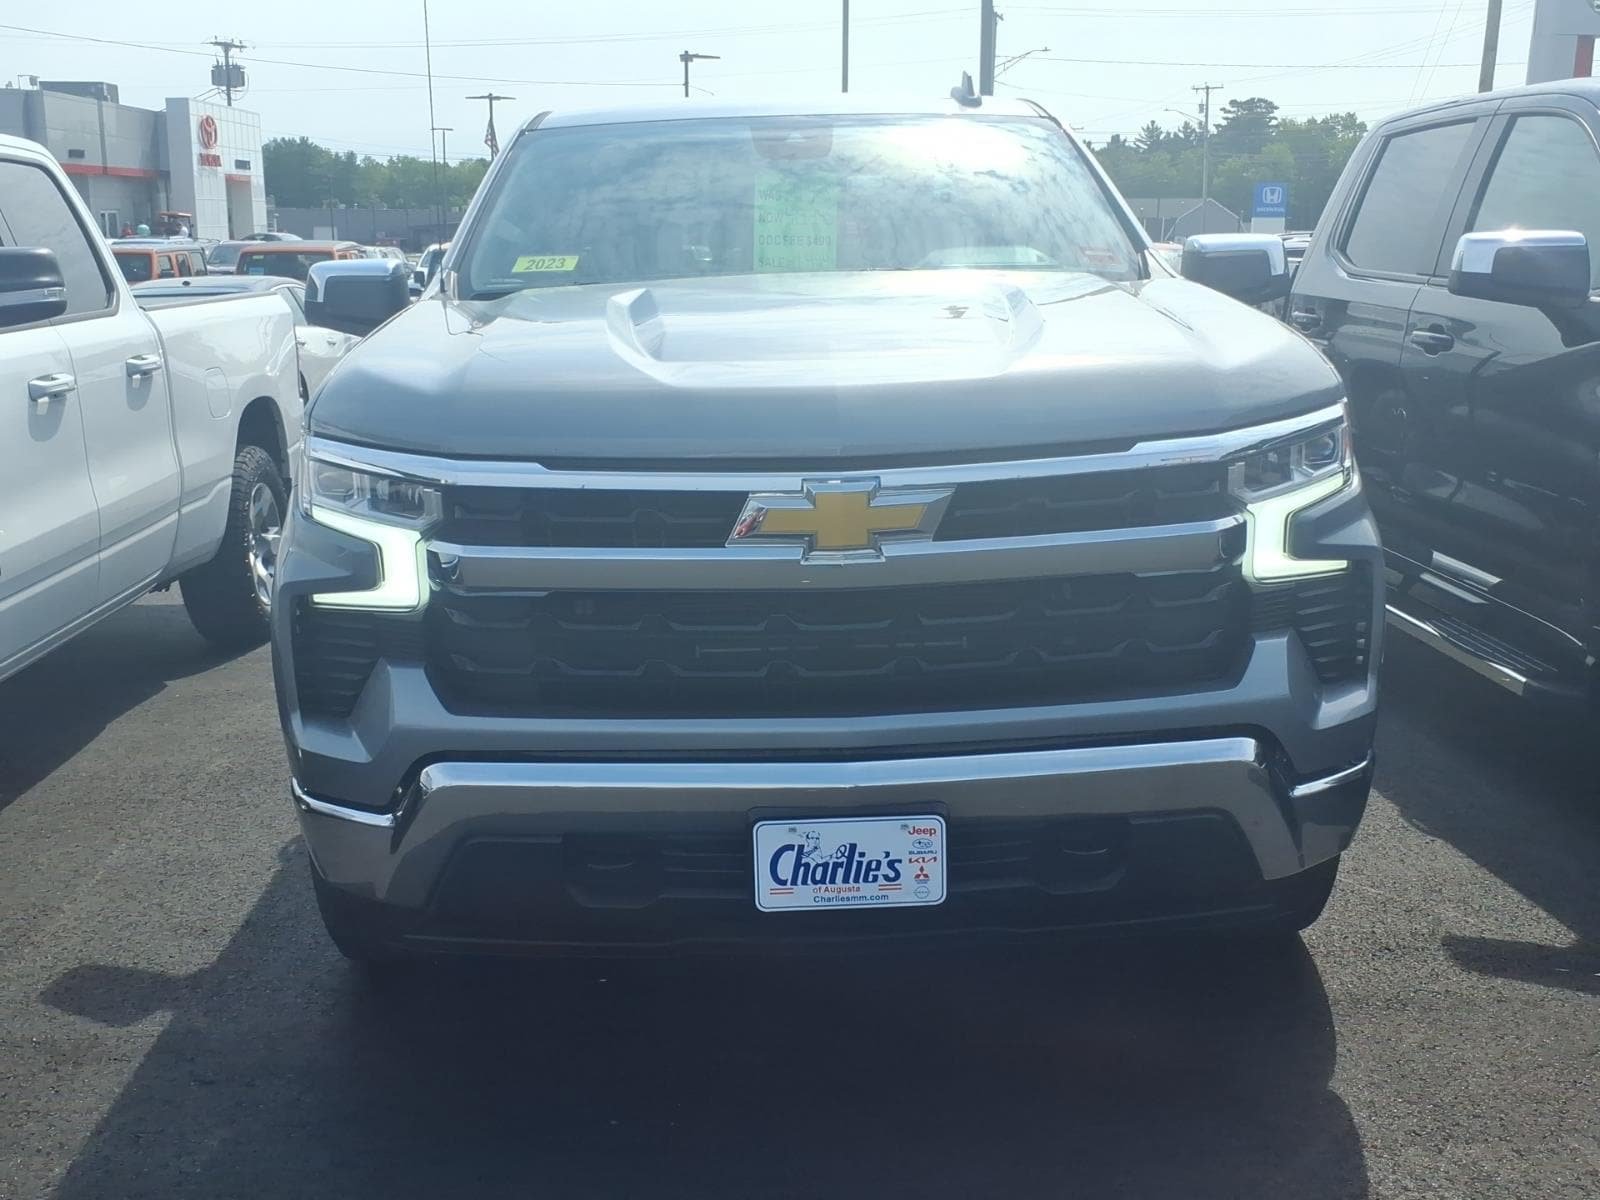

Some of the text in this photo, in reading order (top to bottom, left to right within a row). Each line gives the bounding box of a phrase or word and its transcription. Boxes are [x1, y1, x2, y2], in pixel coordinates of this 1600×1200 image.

[524, 257, 566, 270] 2023
[908, 826, 937, 836] Jeep
[769, 843, 903, 887] Charlie's
[824, 885, 861, 895] Augusta
[813, 893, 889, 904] Charliesmm.com
